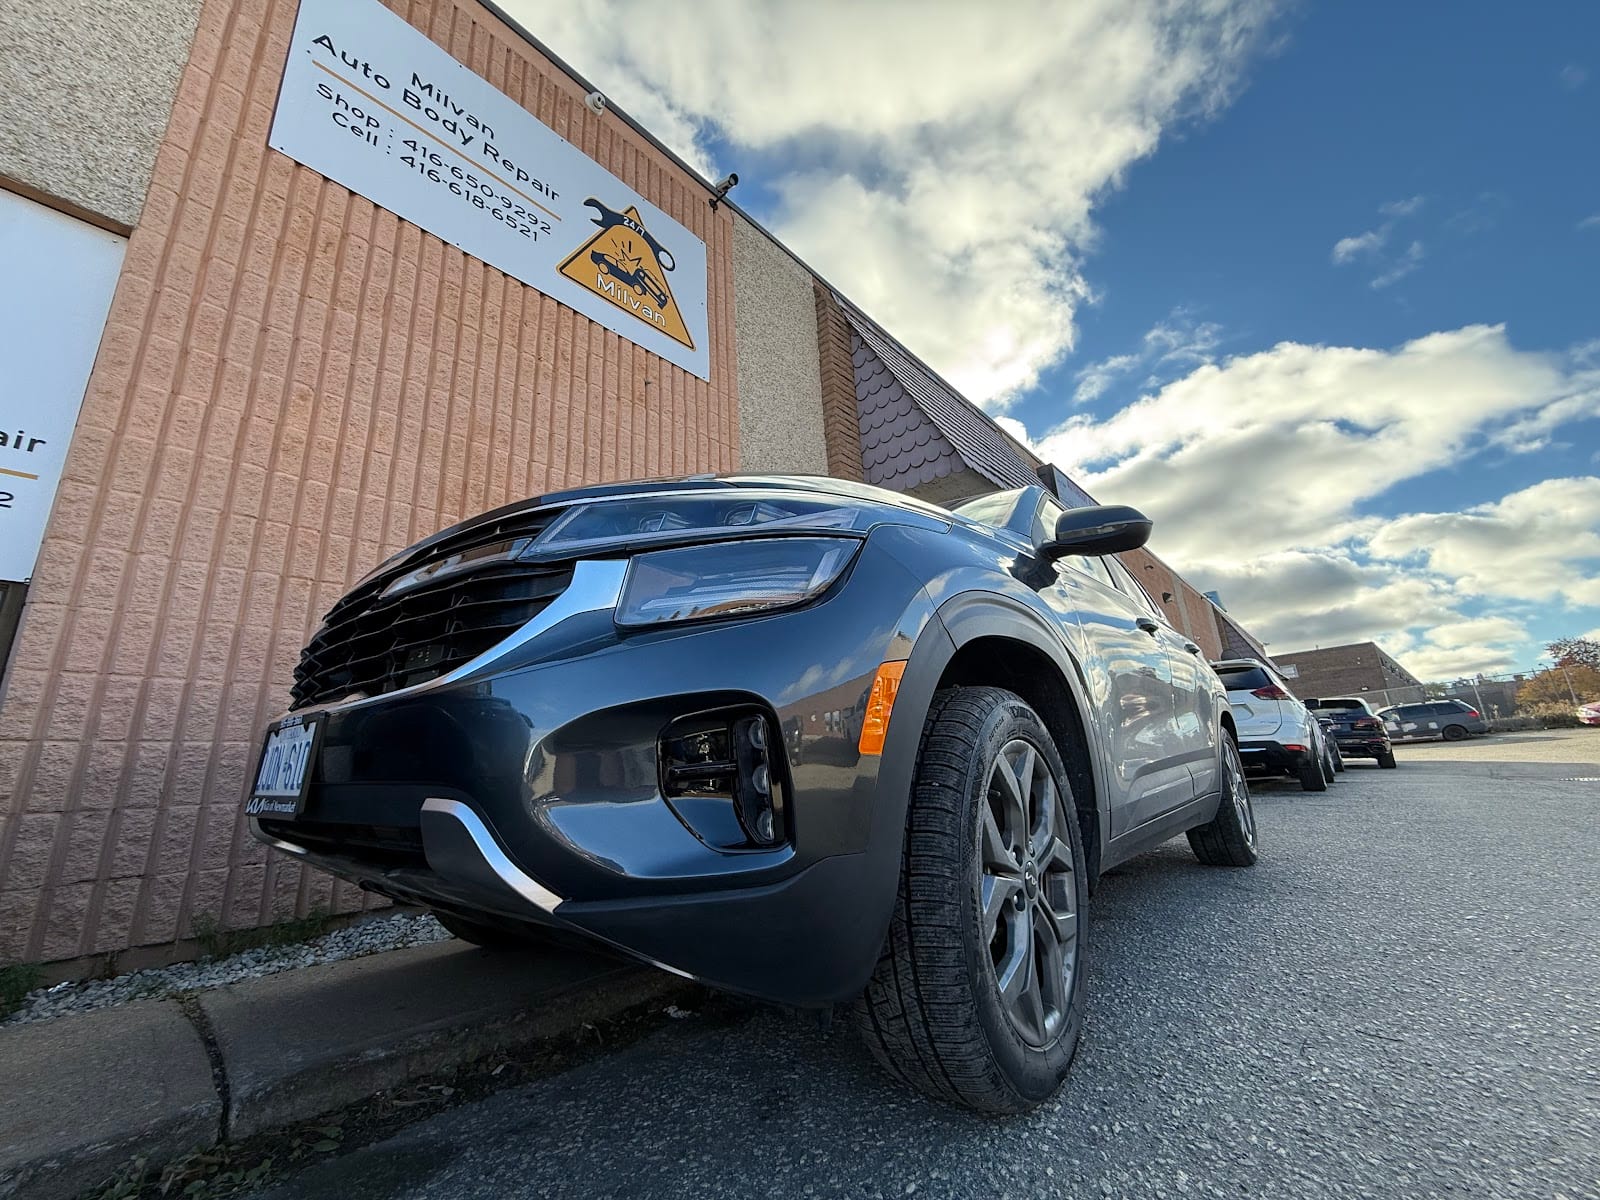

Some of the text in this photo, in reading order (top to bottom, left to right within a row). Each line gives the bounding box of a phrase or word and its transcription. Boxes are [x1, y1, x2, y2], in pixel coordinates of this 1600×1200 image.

[312, 34, 560, 201] Auto Body Repair
[411, 72, 495, 140] Milvan
[316, 83, 380, 129] Shop
[402, 139, 552, 235] 416-650-9292
[332, 112, 378, 147] Cell
[399, 156, 538, 242] 416-618-6521
[623, 216, 645, 236] 24/7
[597, 273, 667, 328] Milvan
